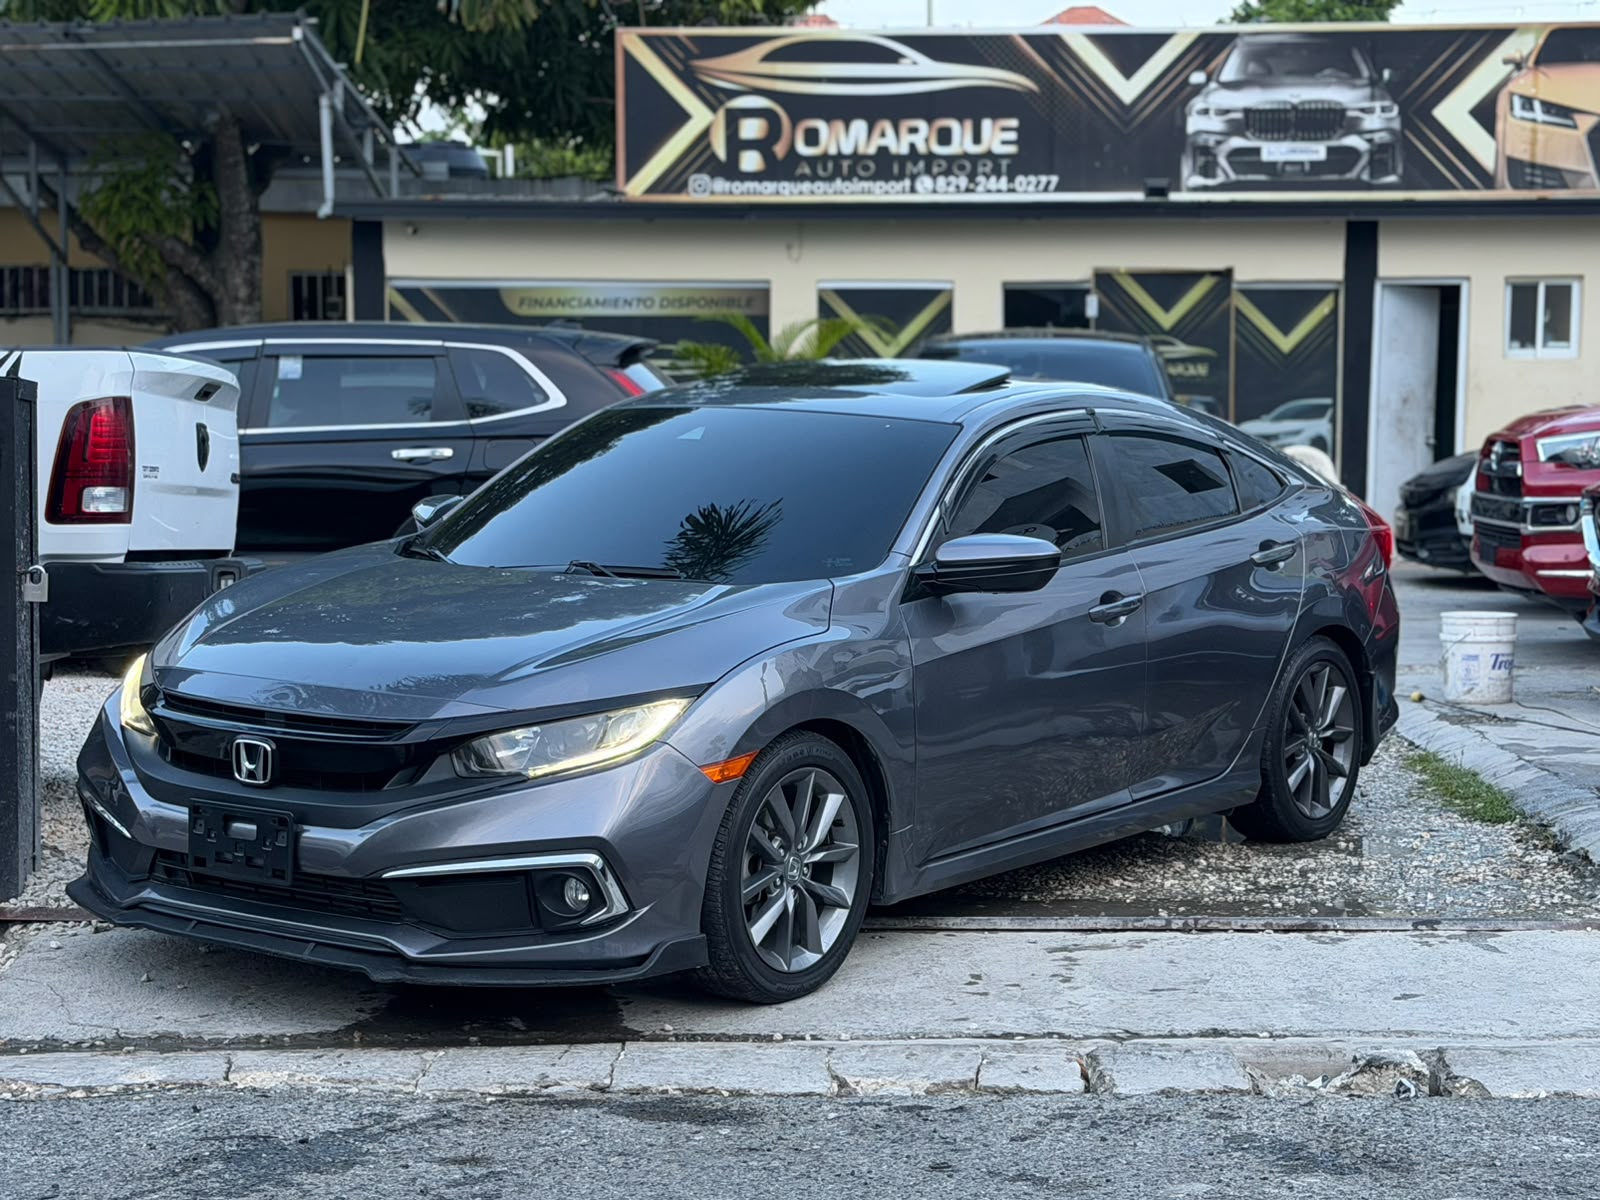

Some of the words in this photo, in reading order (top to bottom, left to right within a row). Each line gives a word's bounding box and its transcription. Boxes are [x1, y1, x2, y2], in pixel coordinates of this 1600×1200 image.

[795, 159, 876, 177] AUTO
[893, 158, 1012, 176] IMPORT
[935, 174, 1060, 193] 829-244-0277
[518, 295, 656, 311] FINANCIAMIENTO
[658, 295, 755, 311] DISPONIBLE
